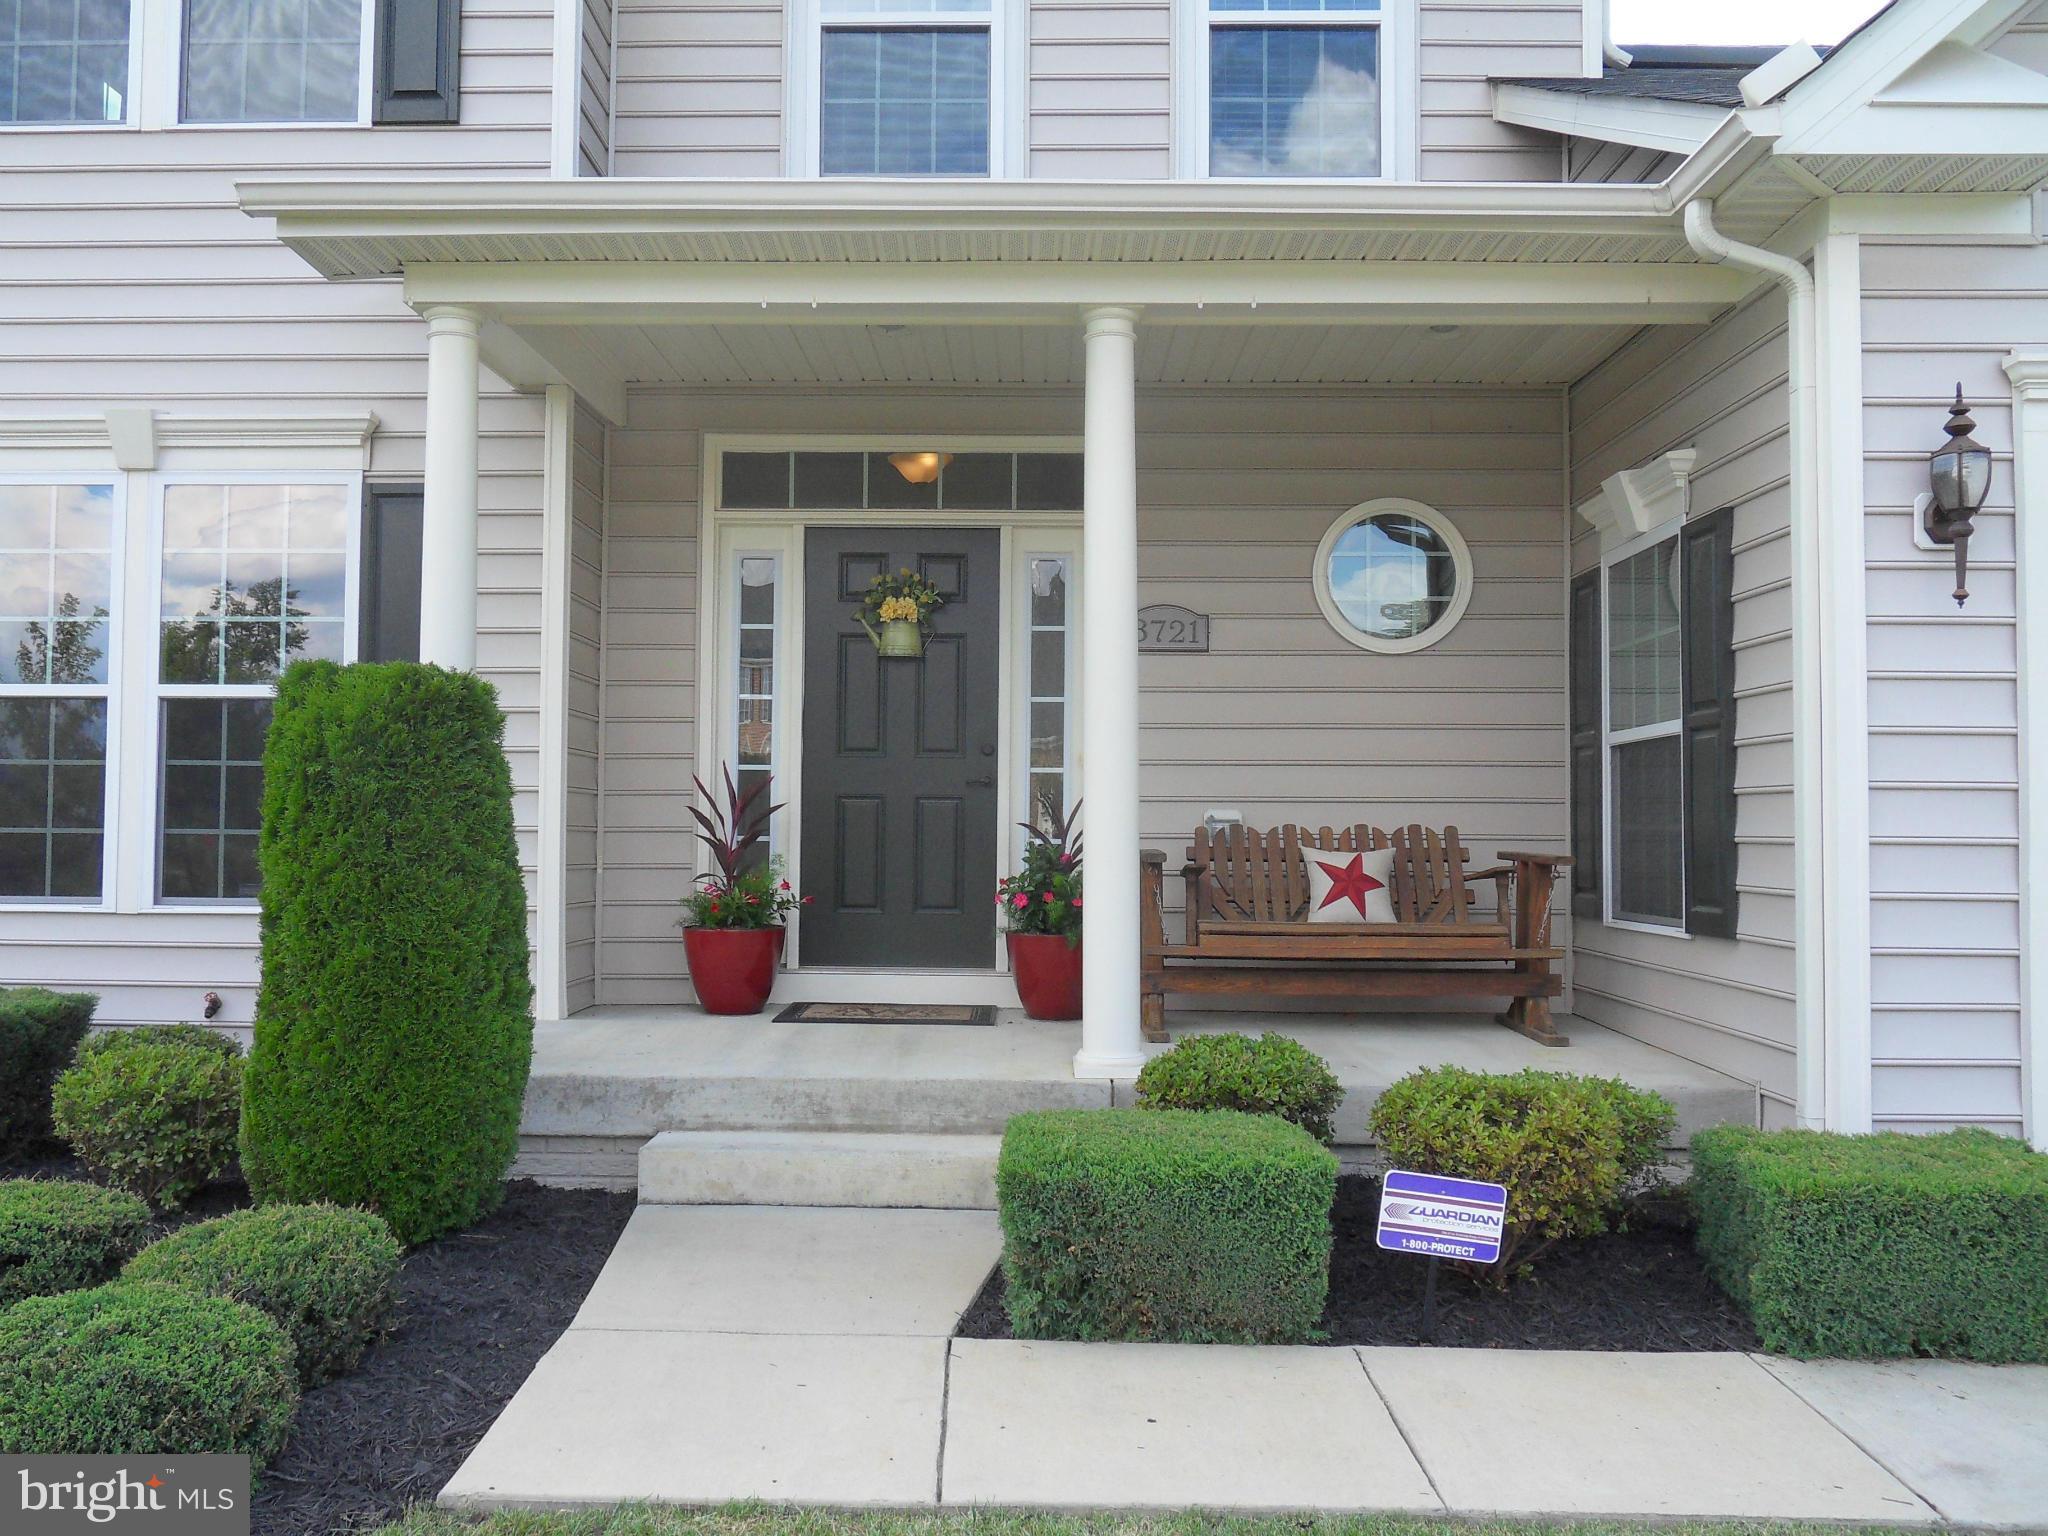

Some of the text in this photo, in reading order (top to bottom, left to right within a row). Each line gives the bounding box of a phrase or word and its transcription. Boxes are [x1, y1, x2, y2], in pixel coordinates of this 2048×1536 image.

[1409, 1206, 1500, 1226] GUARDIAN
[1422, 1217, 1499, 1233] protection services
[1401, 1238, 1475, 1257] 1-800-PROTECT
